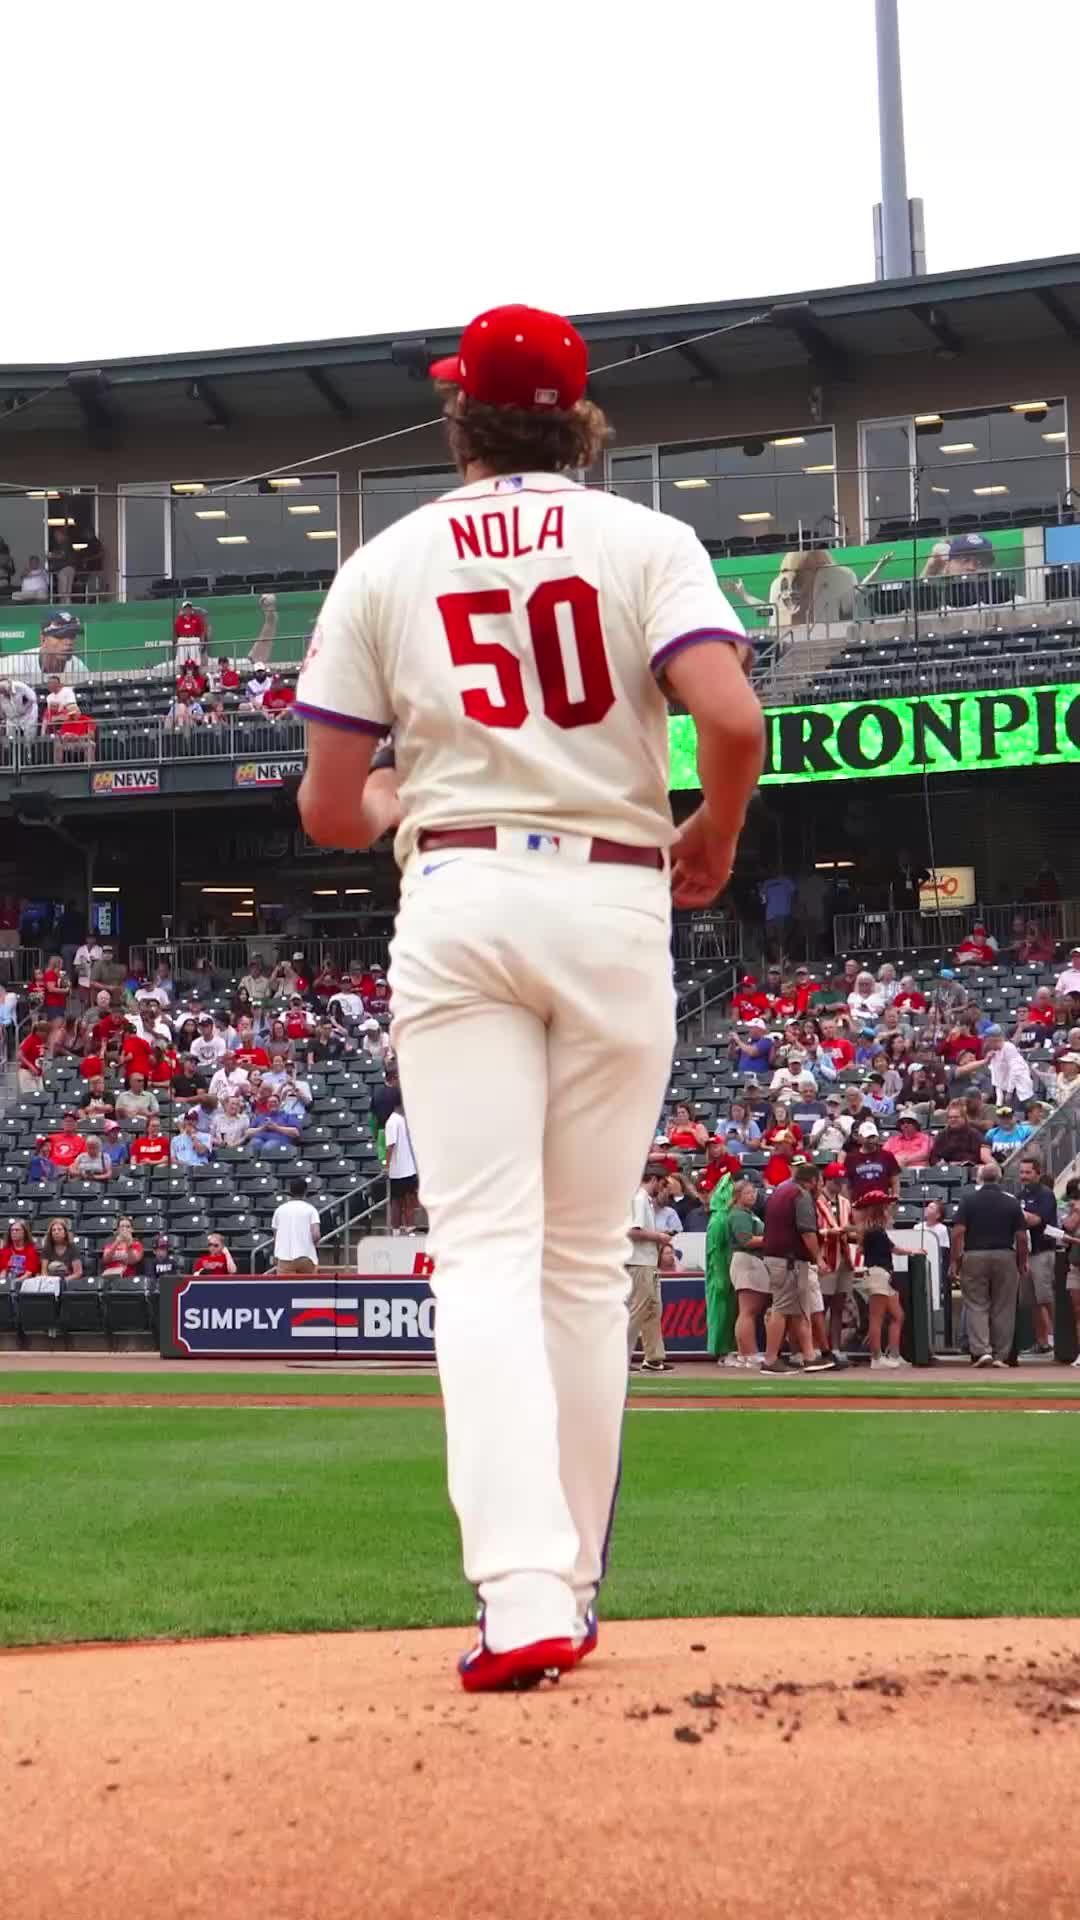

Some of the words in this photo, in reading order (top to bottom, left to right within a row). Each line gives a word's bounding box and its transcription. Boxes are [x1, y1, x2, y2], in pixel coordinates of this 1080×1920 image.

[448, 505, 564, 560] NOLA
[436, 575, 616, 729] 50
[113, 771, 158, 787] NEWS
[257, 763, 302, 779] NEWS
[183, 1307, 285, 1330] SIMPLY
